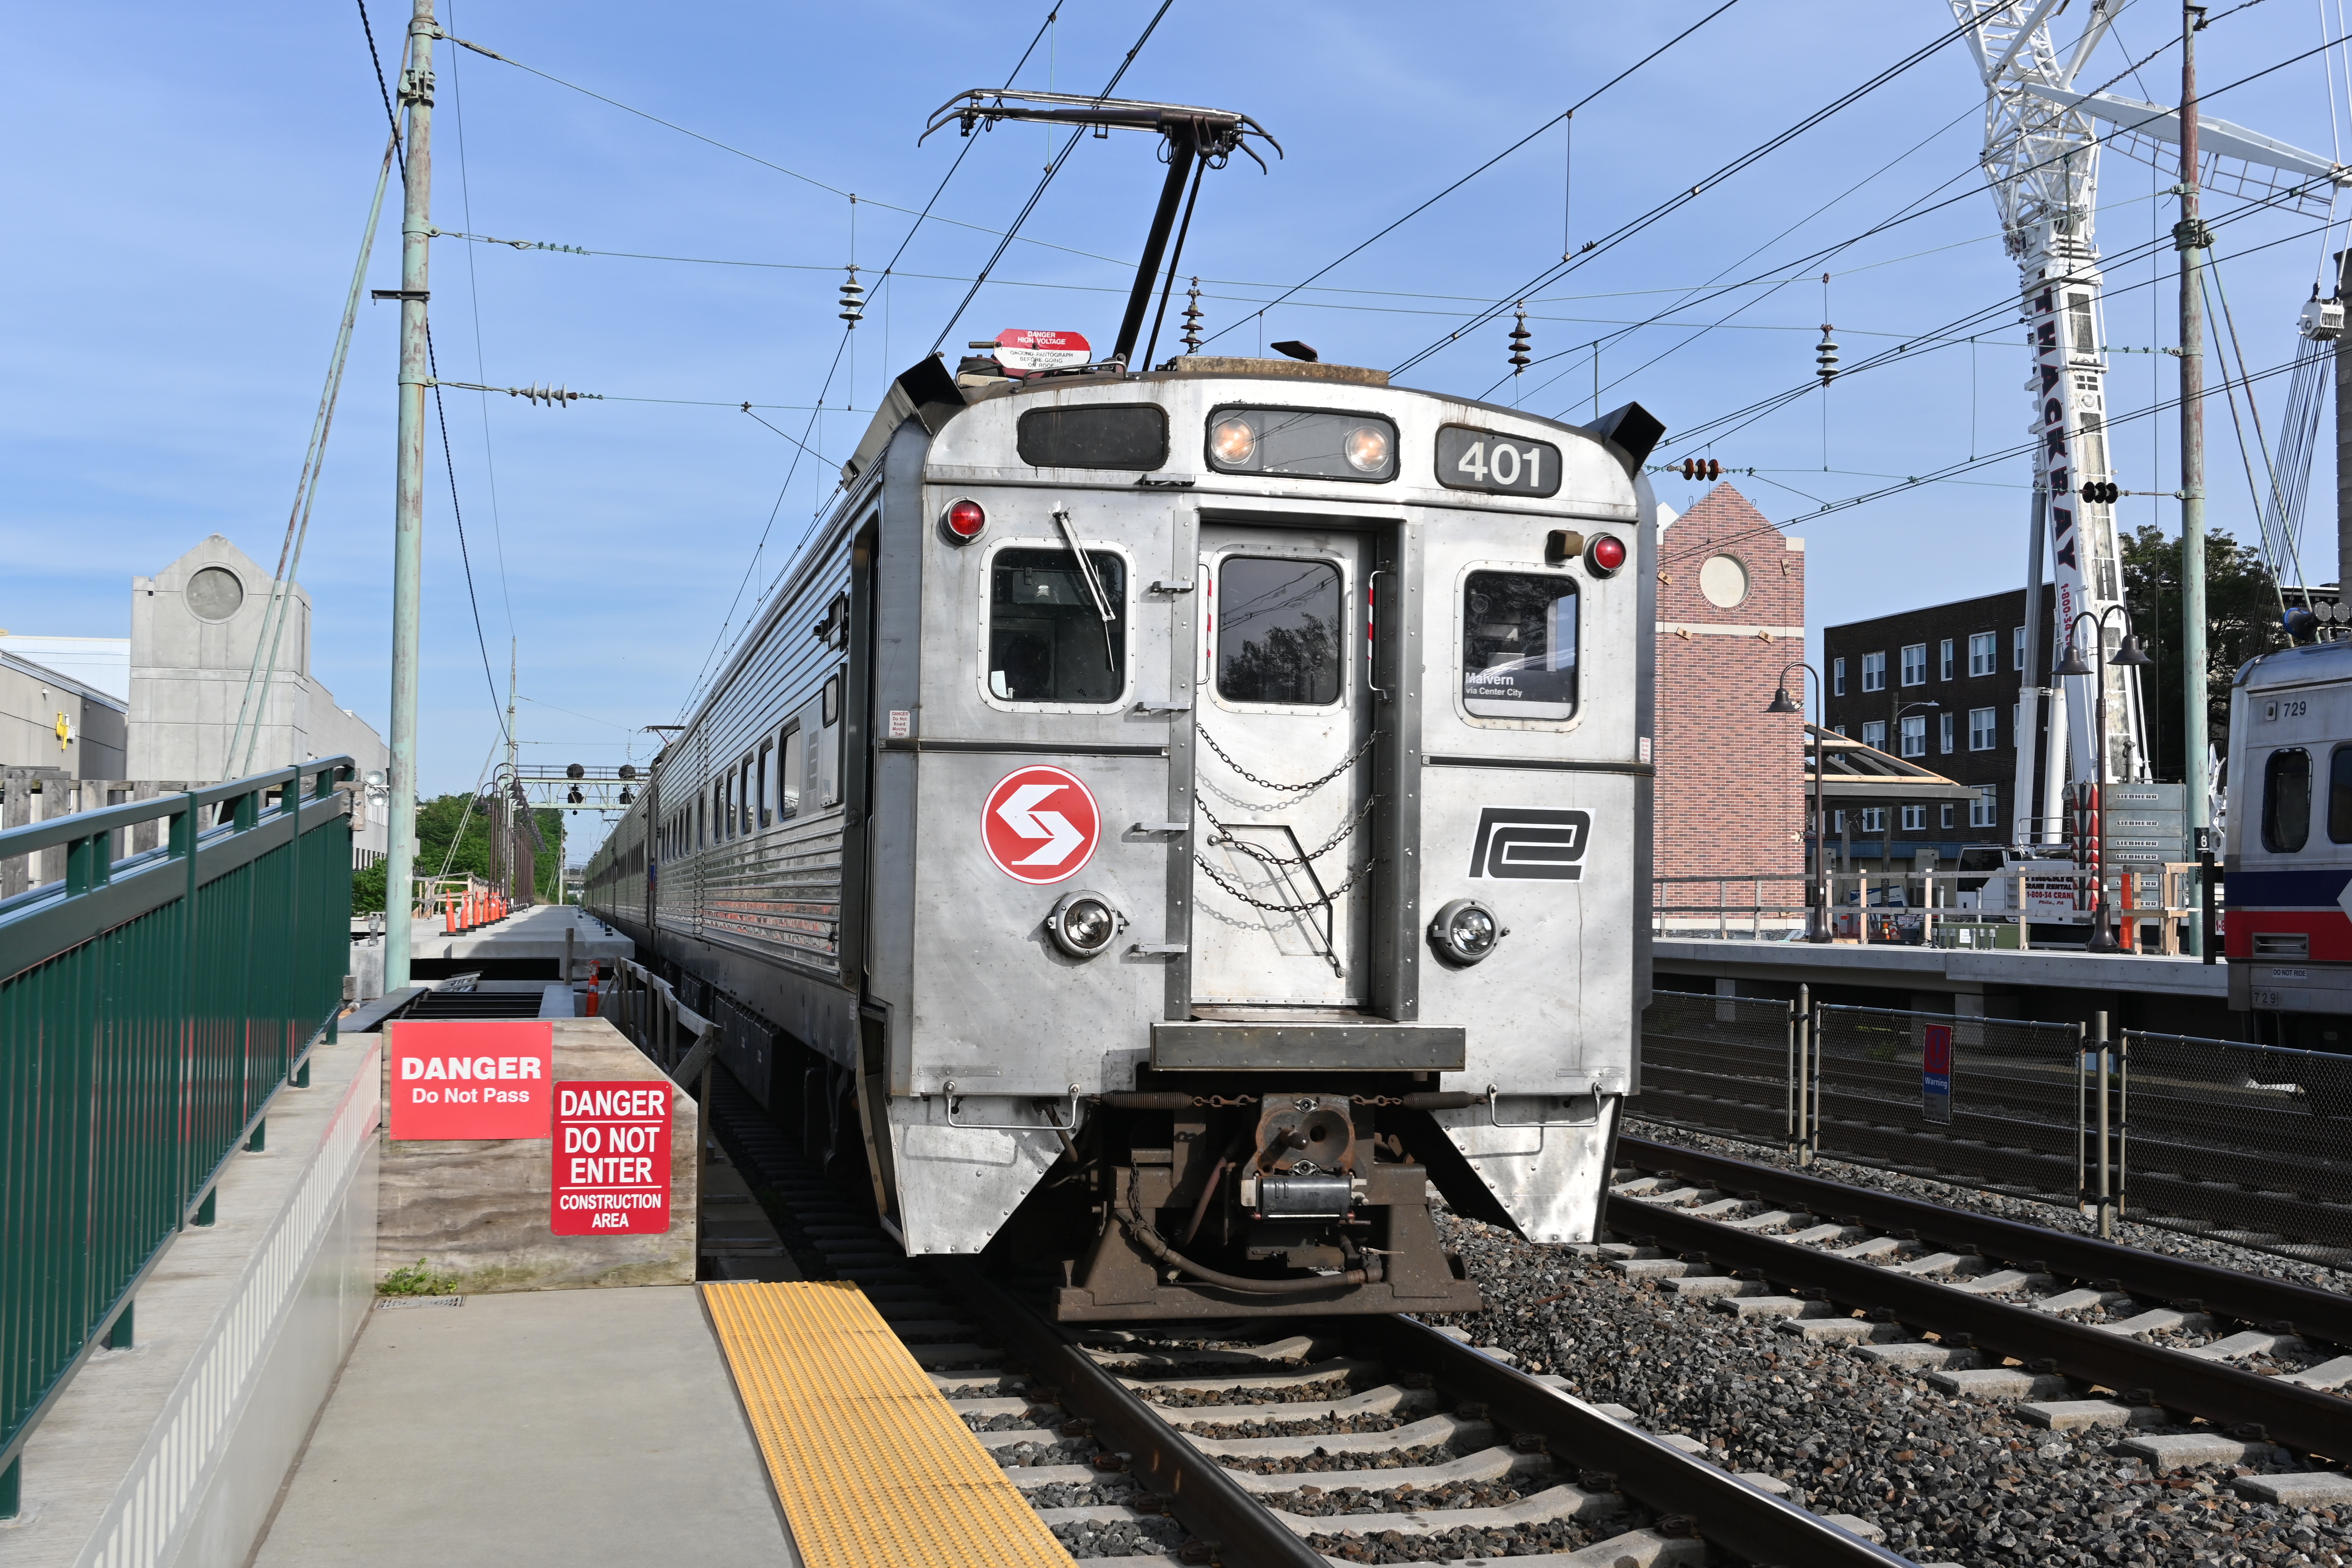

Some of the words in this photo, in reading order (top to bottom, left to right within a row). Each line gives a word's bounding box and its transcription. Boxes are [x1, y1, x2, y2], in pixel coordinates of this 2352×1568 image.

[2035, 286, 2076, 570] THACKRAY
[1458, 441, 1540, 487] 401
[2061, 583, 2073, 631] 1-800-34
[1465, 672, 1514, 685] Malvern
[1479, 687, 1505, 695] Center
[1507, 689, 1523, 697] City
[2284, 701, 2306, 717] 729
[2201, 835, 2207, 847] 8
[2254, 992, 2276, 1004] 729
[401, 1056, 541, 1080] DANGER
[1925, 1076, 1947, 1089] Warning
[412, 1088, 438, 1103] Do
[445, 1088, 478, 1103] Not
[483, 1087, 530, 1102] Pass
[560, 1090, 665, 1116] DANGER
[565, 1127, 601, 1153] DO
[609, 1127, 660, 1153] NOT
[571, 1157, 653, 1183] ENTER
[560, 1194, 662, 1209] CONSTRUCTION
[591, 1213, 629, 1228] AREA
